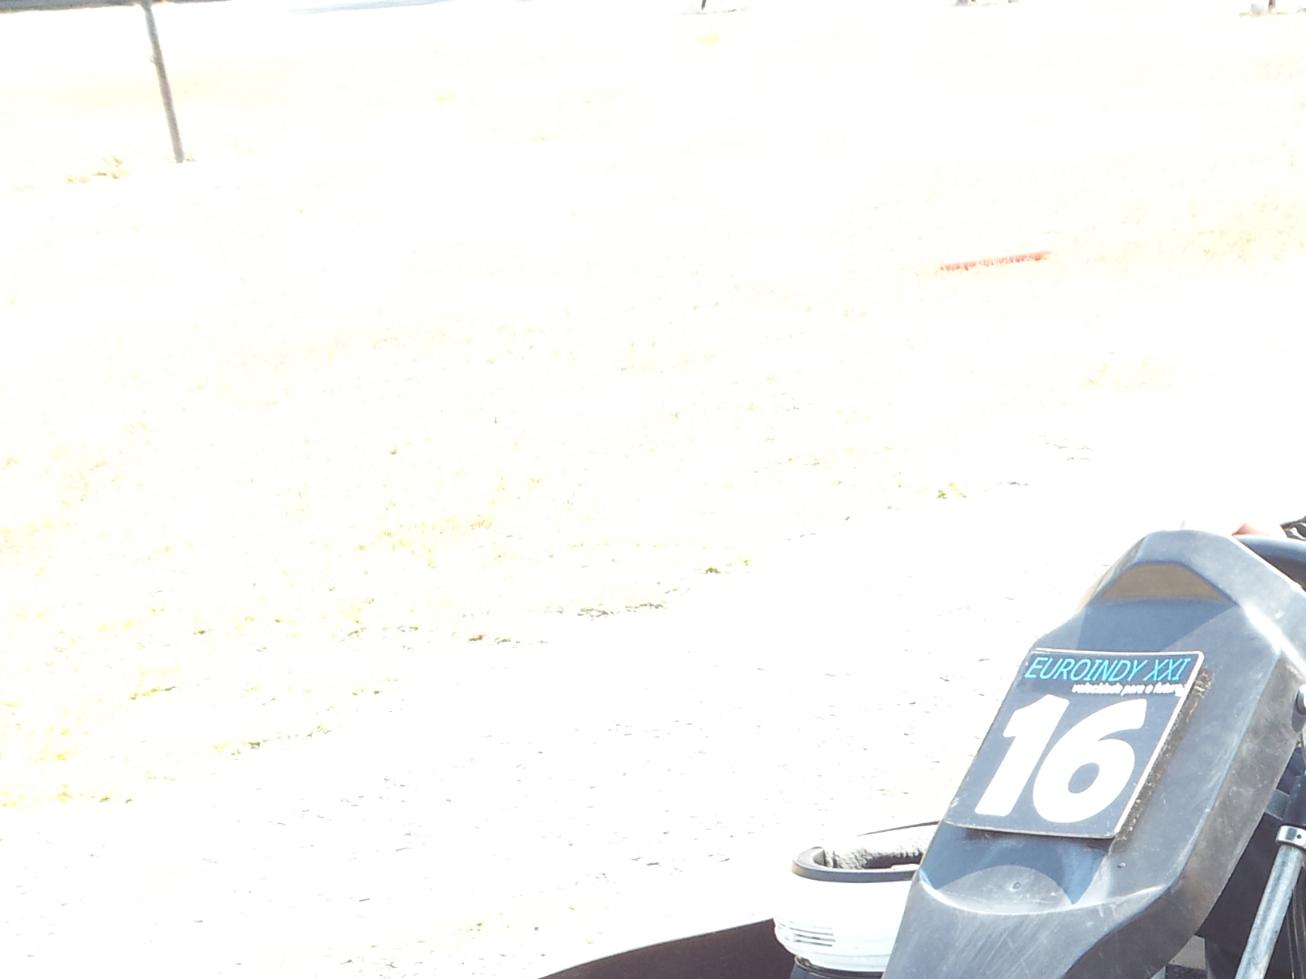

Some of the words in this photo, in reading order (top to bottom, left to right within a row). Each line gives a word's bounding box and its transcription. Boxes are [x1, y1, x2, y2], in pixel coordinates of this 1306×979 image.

[1023, 656, 1148, 682] EUROINDY
[1142, 656, 1192, 682] XXI
[974, 693, 1148, 823] 16
